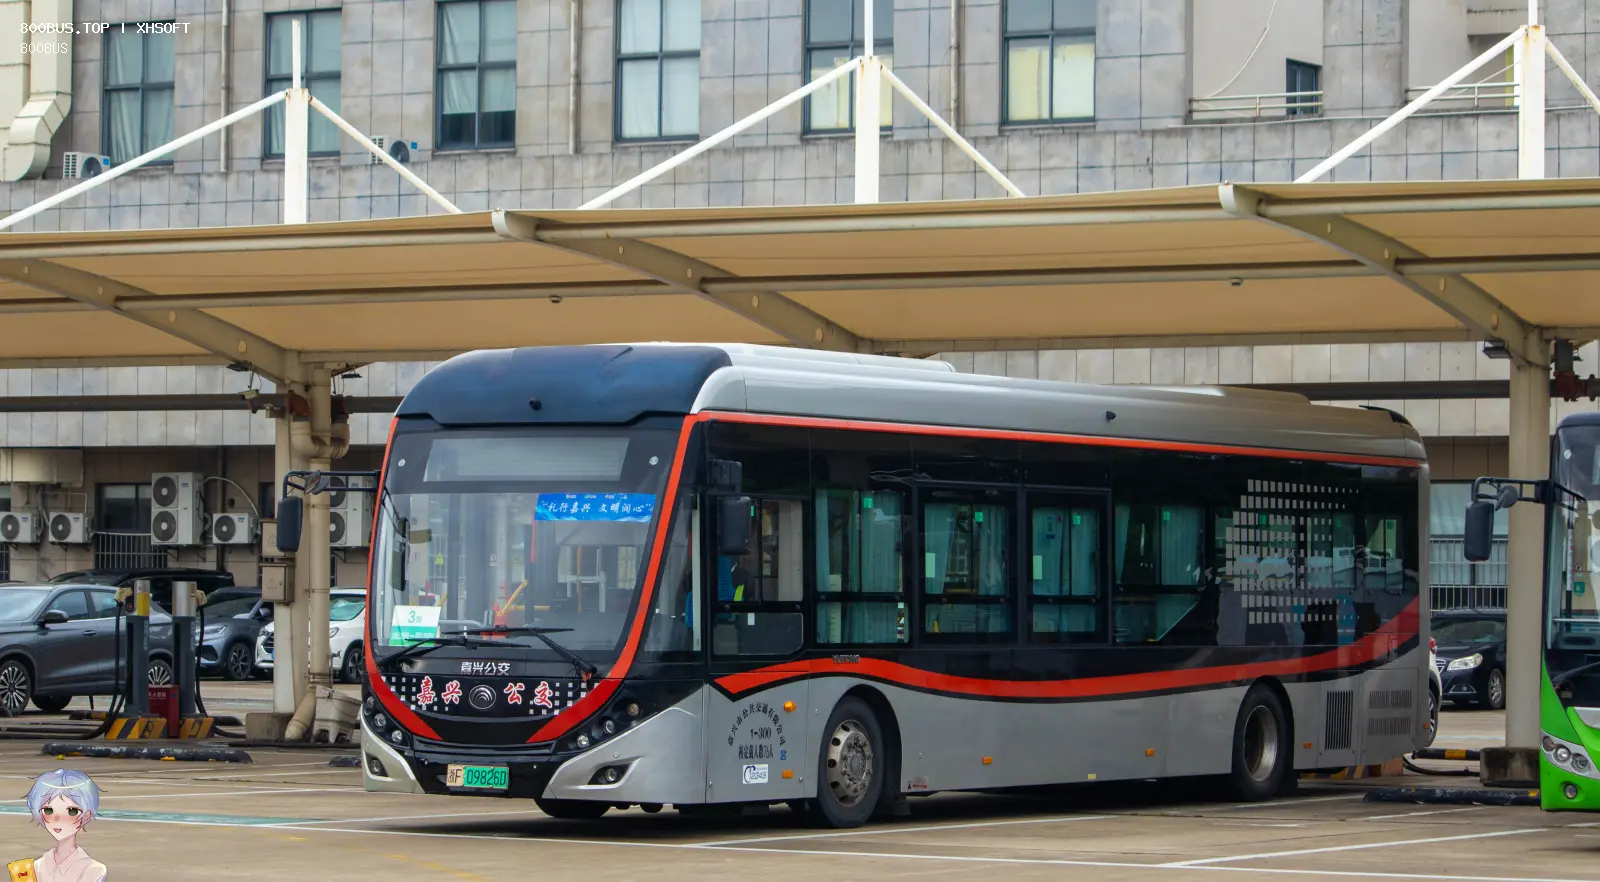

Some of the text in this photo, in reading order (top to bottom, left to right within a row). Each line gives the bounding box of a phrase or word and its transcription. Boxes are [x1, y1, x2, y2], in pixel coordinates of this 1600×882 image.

[460, 661, 510, 676] 嘉兴公交
[417, 676, 553, 708] 嘉兴 公交
